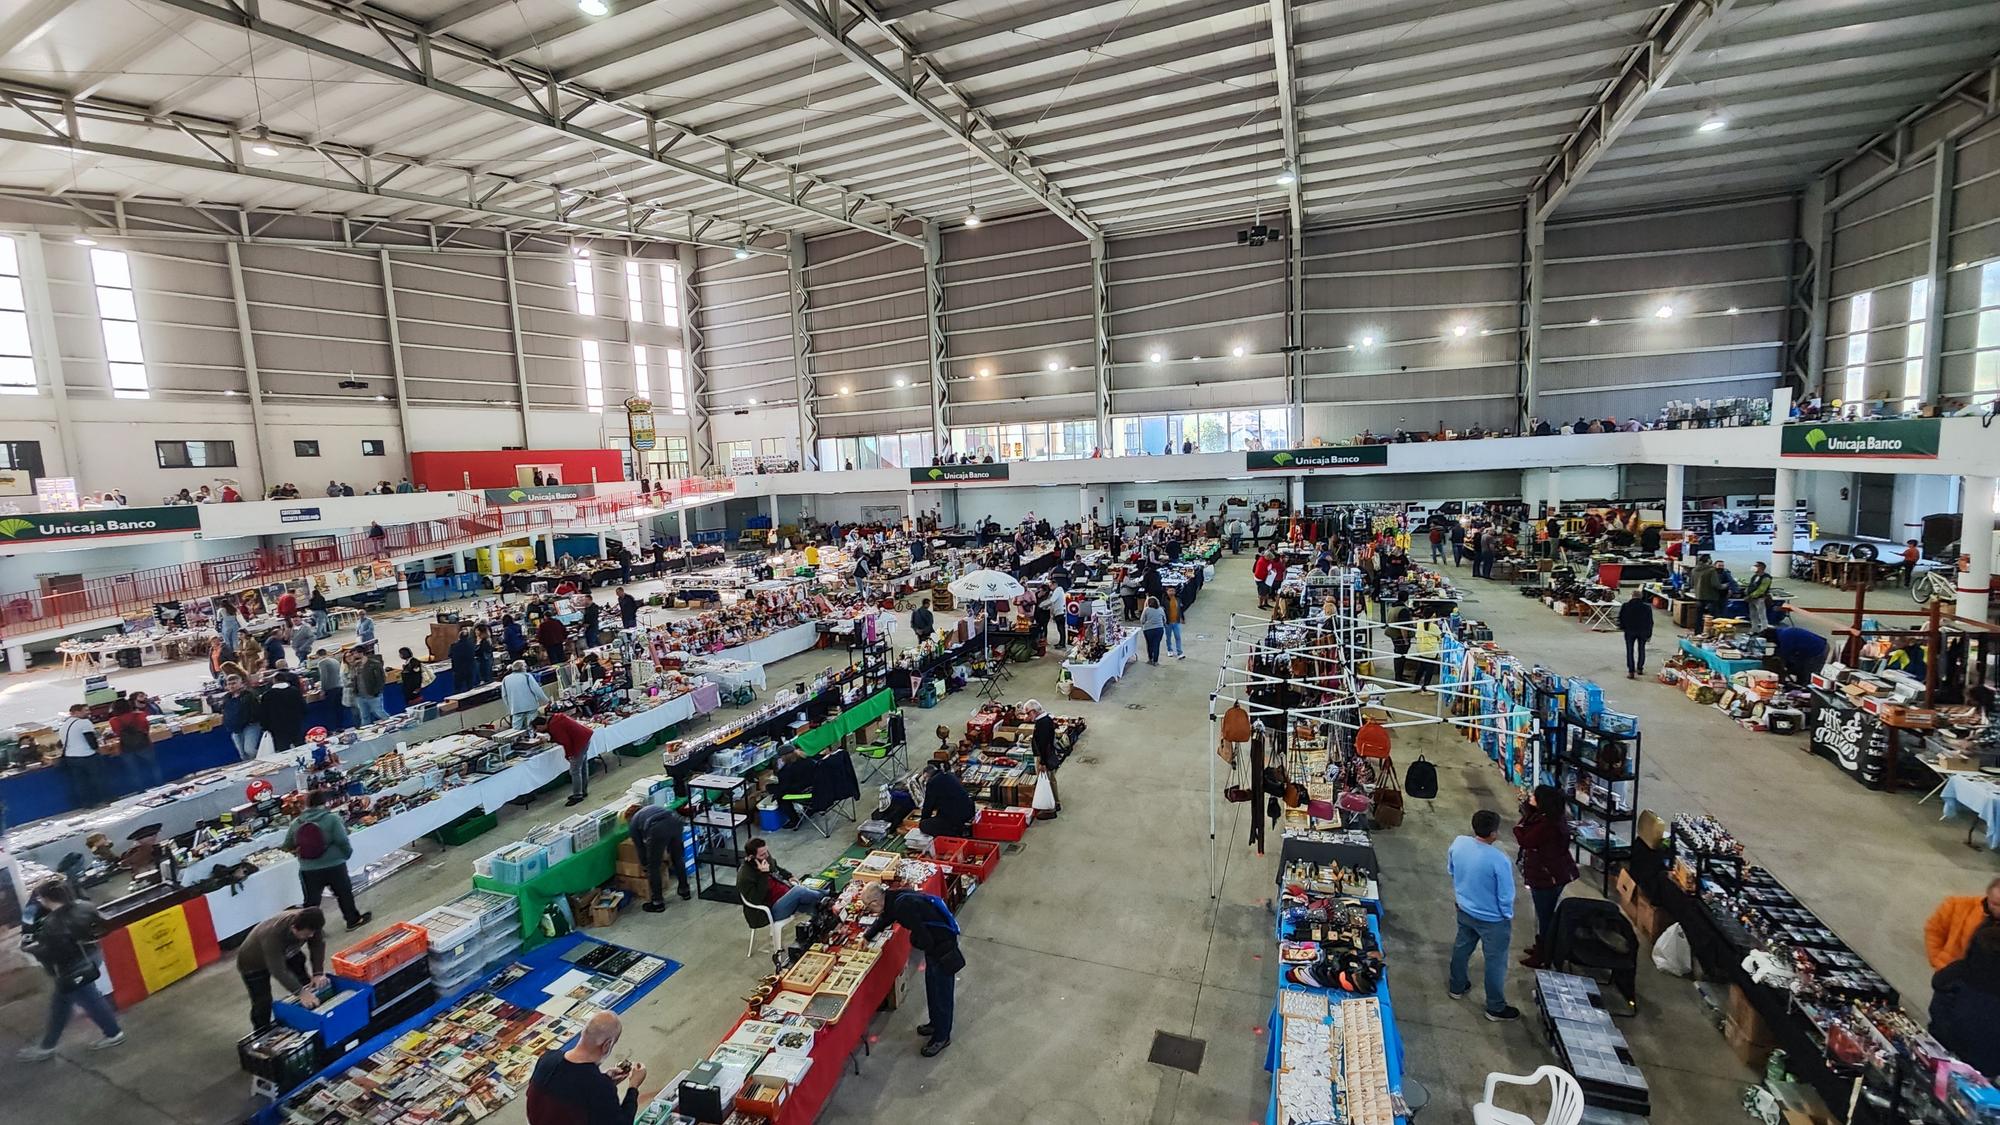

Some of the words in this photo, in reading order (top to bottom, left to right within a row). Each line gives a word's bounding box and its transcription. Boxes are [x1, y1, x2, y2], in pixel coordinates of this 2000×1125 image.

[1827, 435, 1866, 453] Unicaja
[1867, 436, 1902, 450] Banco
[1295, 456, 1330, 466] Unicaja
[1331, 455, 1360, 464] Banco
[943, 472, 968, 480] Unicaja
[968, 471, 989, 479] Banco
[527, 492, 556, 501] Unicaja
[556, 492, 577, 500] Banco
[39, 520, 106, 535] Unicaja
[106, 520, 156, 532] Banco
